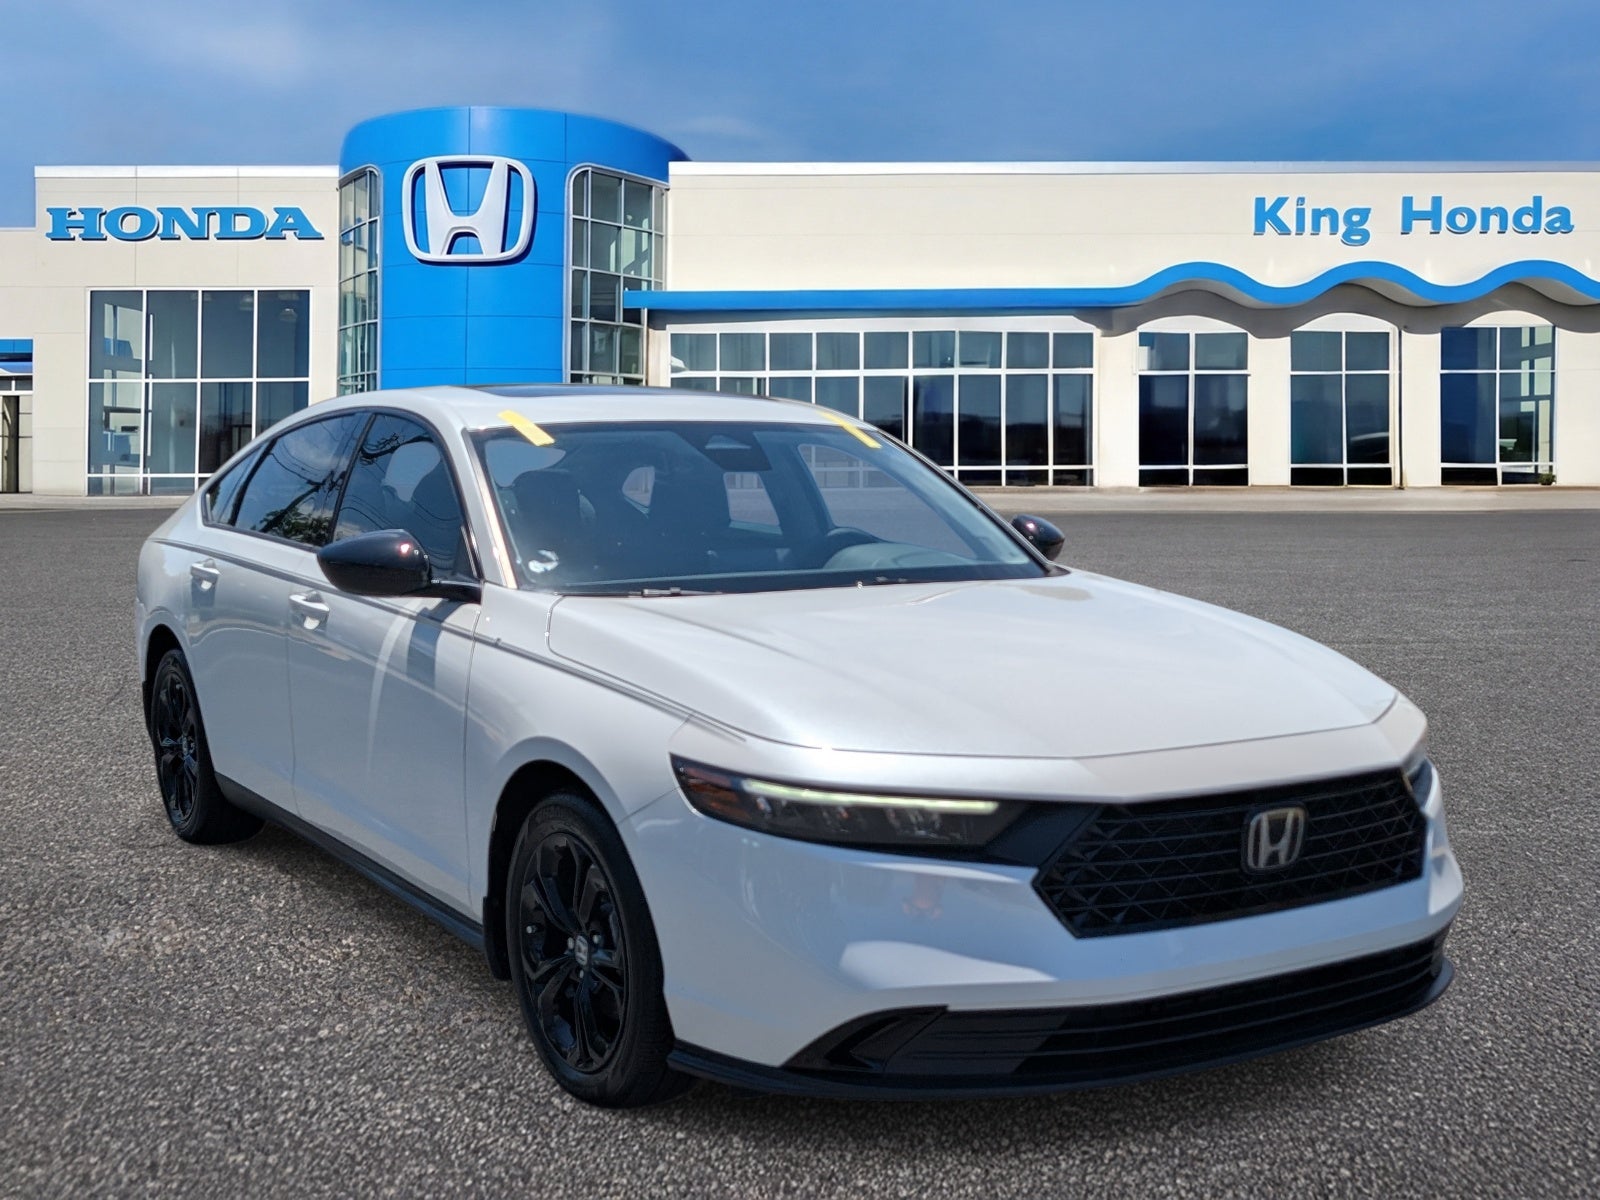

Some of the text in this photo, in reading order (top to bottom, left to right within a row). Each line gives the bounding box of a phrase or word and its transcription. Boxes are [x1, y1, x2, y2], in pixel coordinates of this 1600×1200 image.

[45, 206, 324, 242] HONDA
[1254, 195, 1575, 246] King Honda
